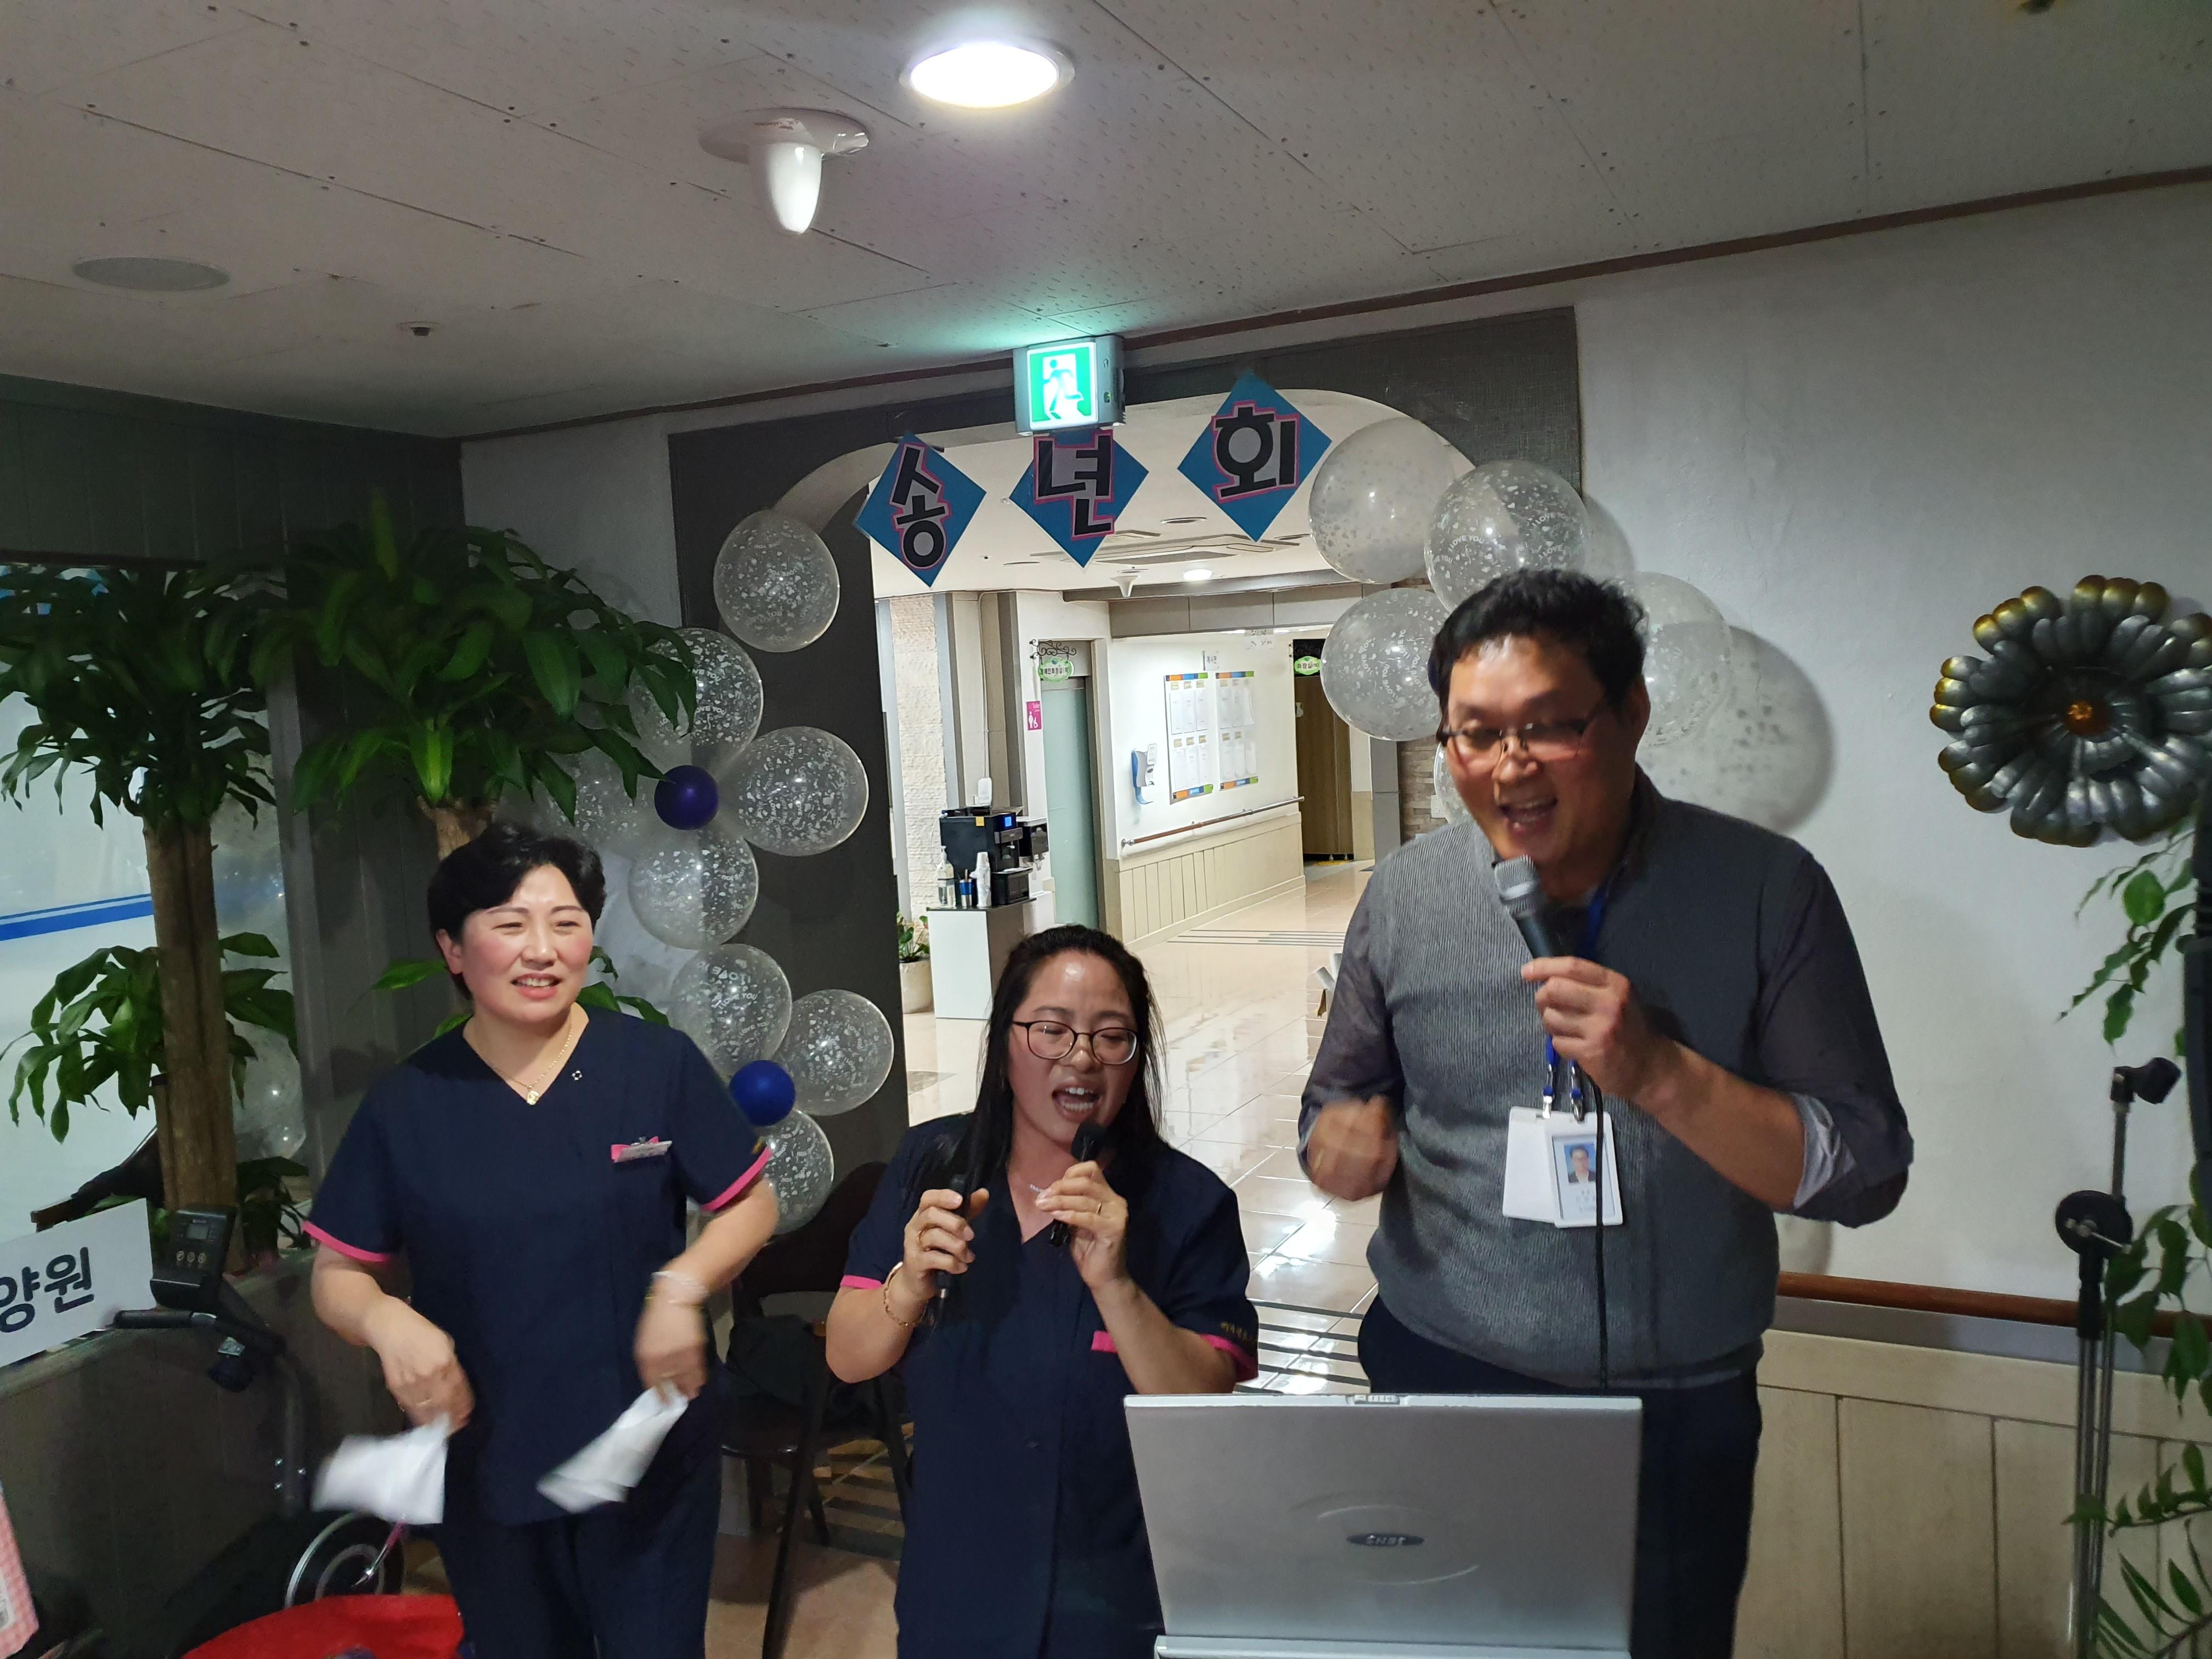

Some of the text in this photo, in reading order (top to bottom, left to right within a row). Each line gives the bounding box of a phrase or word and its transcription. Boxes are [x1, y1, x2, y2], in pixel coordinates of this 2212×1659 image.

[1449, 535, 1467, 549] LOVE
[1468, 535, 1485, 544] YOU
[712, 706, 727, 715] YOU
